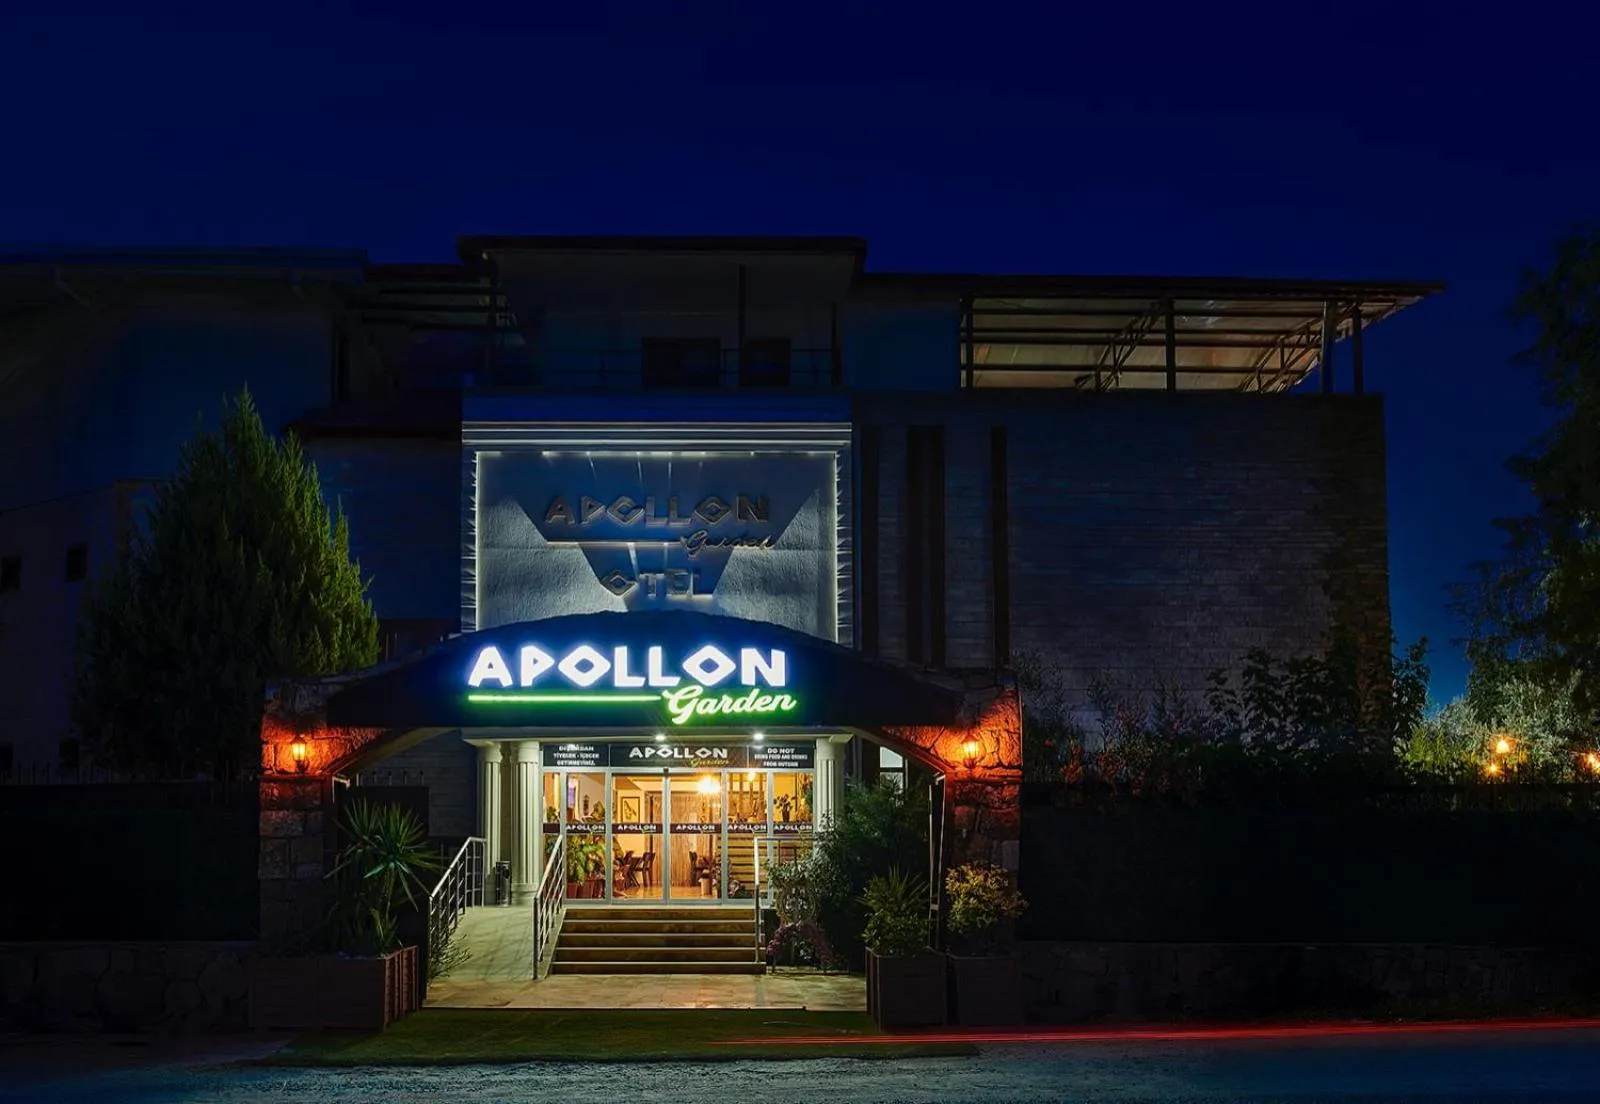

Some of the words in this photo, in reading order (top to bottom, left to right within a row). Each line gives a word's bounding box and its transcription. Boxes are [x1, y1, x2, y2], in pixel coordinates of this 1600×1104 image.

[543, 494, 769, 527] APOLLON
[600, 568, 715, 600] OTEL
[467, 644, 787, 688] APOLLON
[661, 684, 797, 725] Garden
[629, 747, 728, 758] APOLLON
